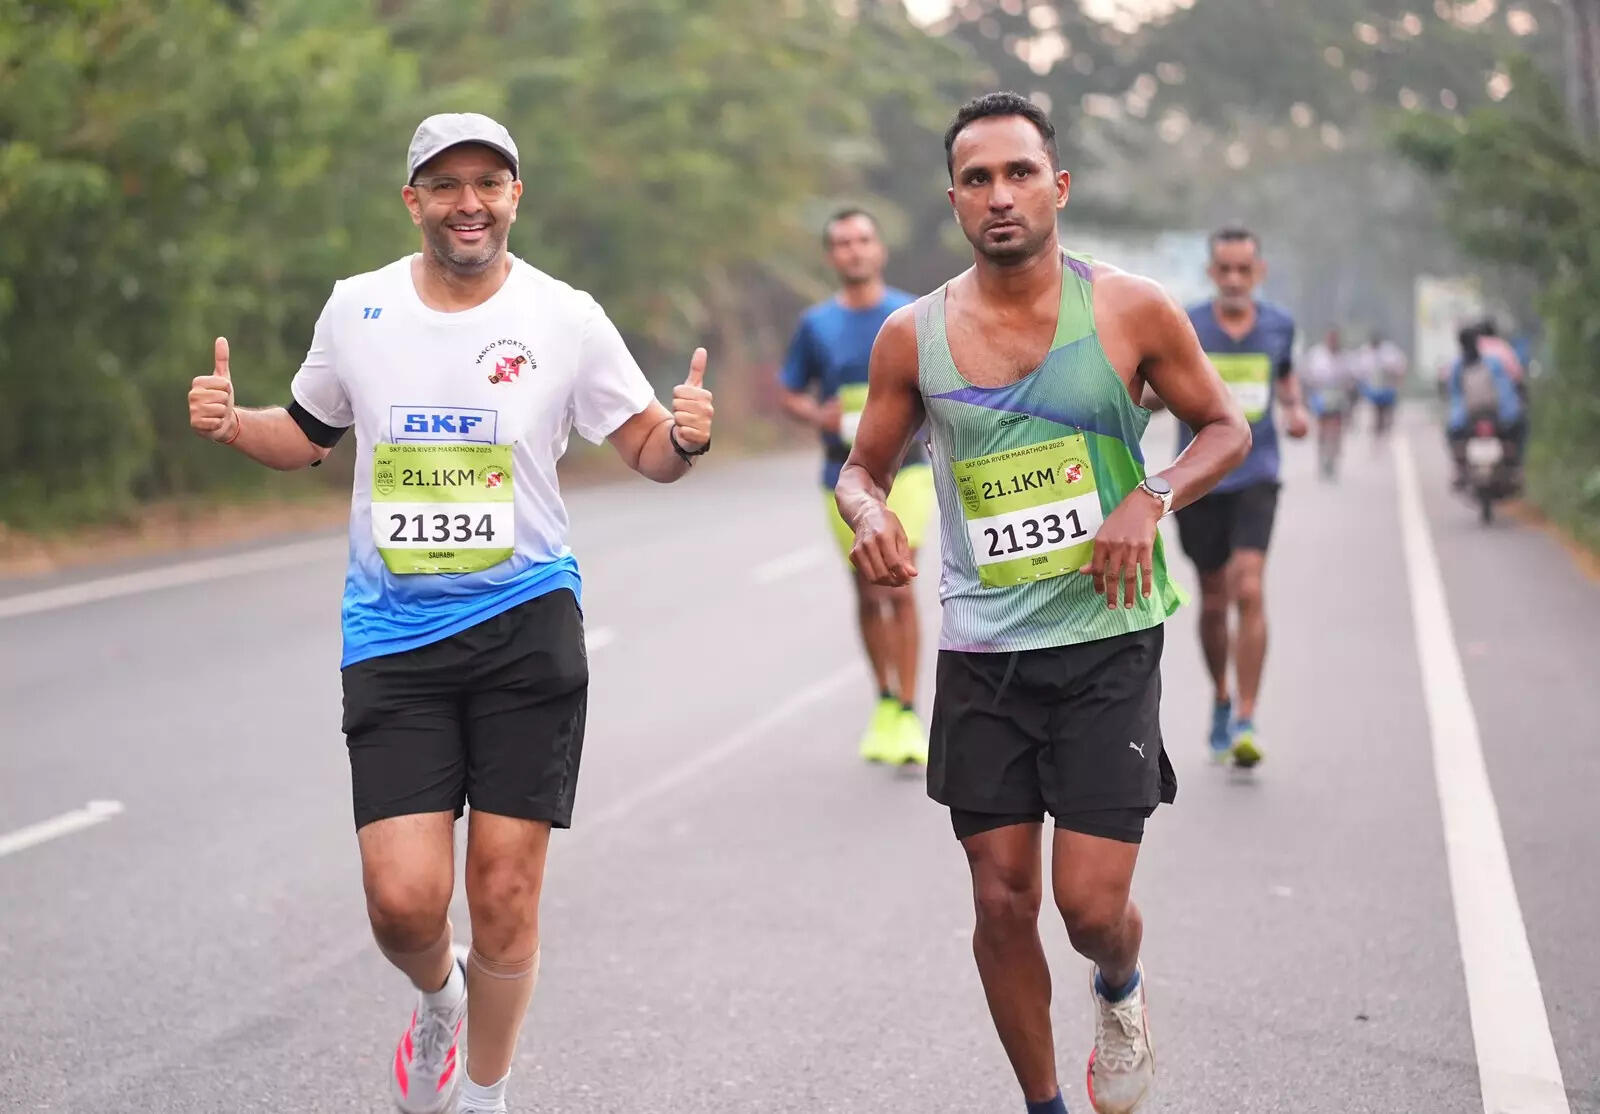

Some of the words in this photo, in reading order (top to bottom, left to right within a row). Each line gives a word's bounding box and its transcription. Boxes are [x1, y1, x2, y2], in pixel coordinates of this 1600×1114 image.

[475, 342, 496, 365] VASCO
[497, 339, 527, 351] SPORTS
[526, 350, 537, 370] CLUB
[404, 414, 482, 434] SKF
[476, 446, 492, 454] 2025
[965, 461, 976, 469] SKF
[977, 458, 990, 466] GOA
[991, 454, 1010, 463] RIVER
[1011, 445, 1048, 459] MARATHON
[1049, 440, 1065, 450] 2025
[402, 468, 475, 487] 21.1KM
[981, 467, 1055, 500] 21.1KM
[390, 513, 495, 543] 21334
[984, 509, 1088, 557] 21331
[428, 551, 455, 559] SAURABH
[1031, 555, 1049, 566] ZUBIN
